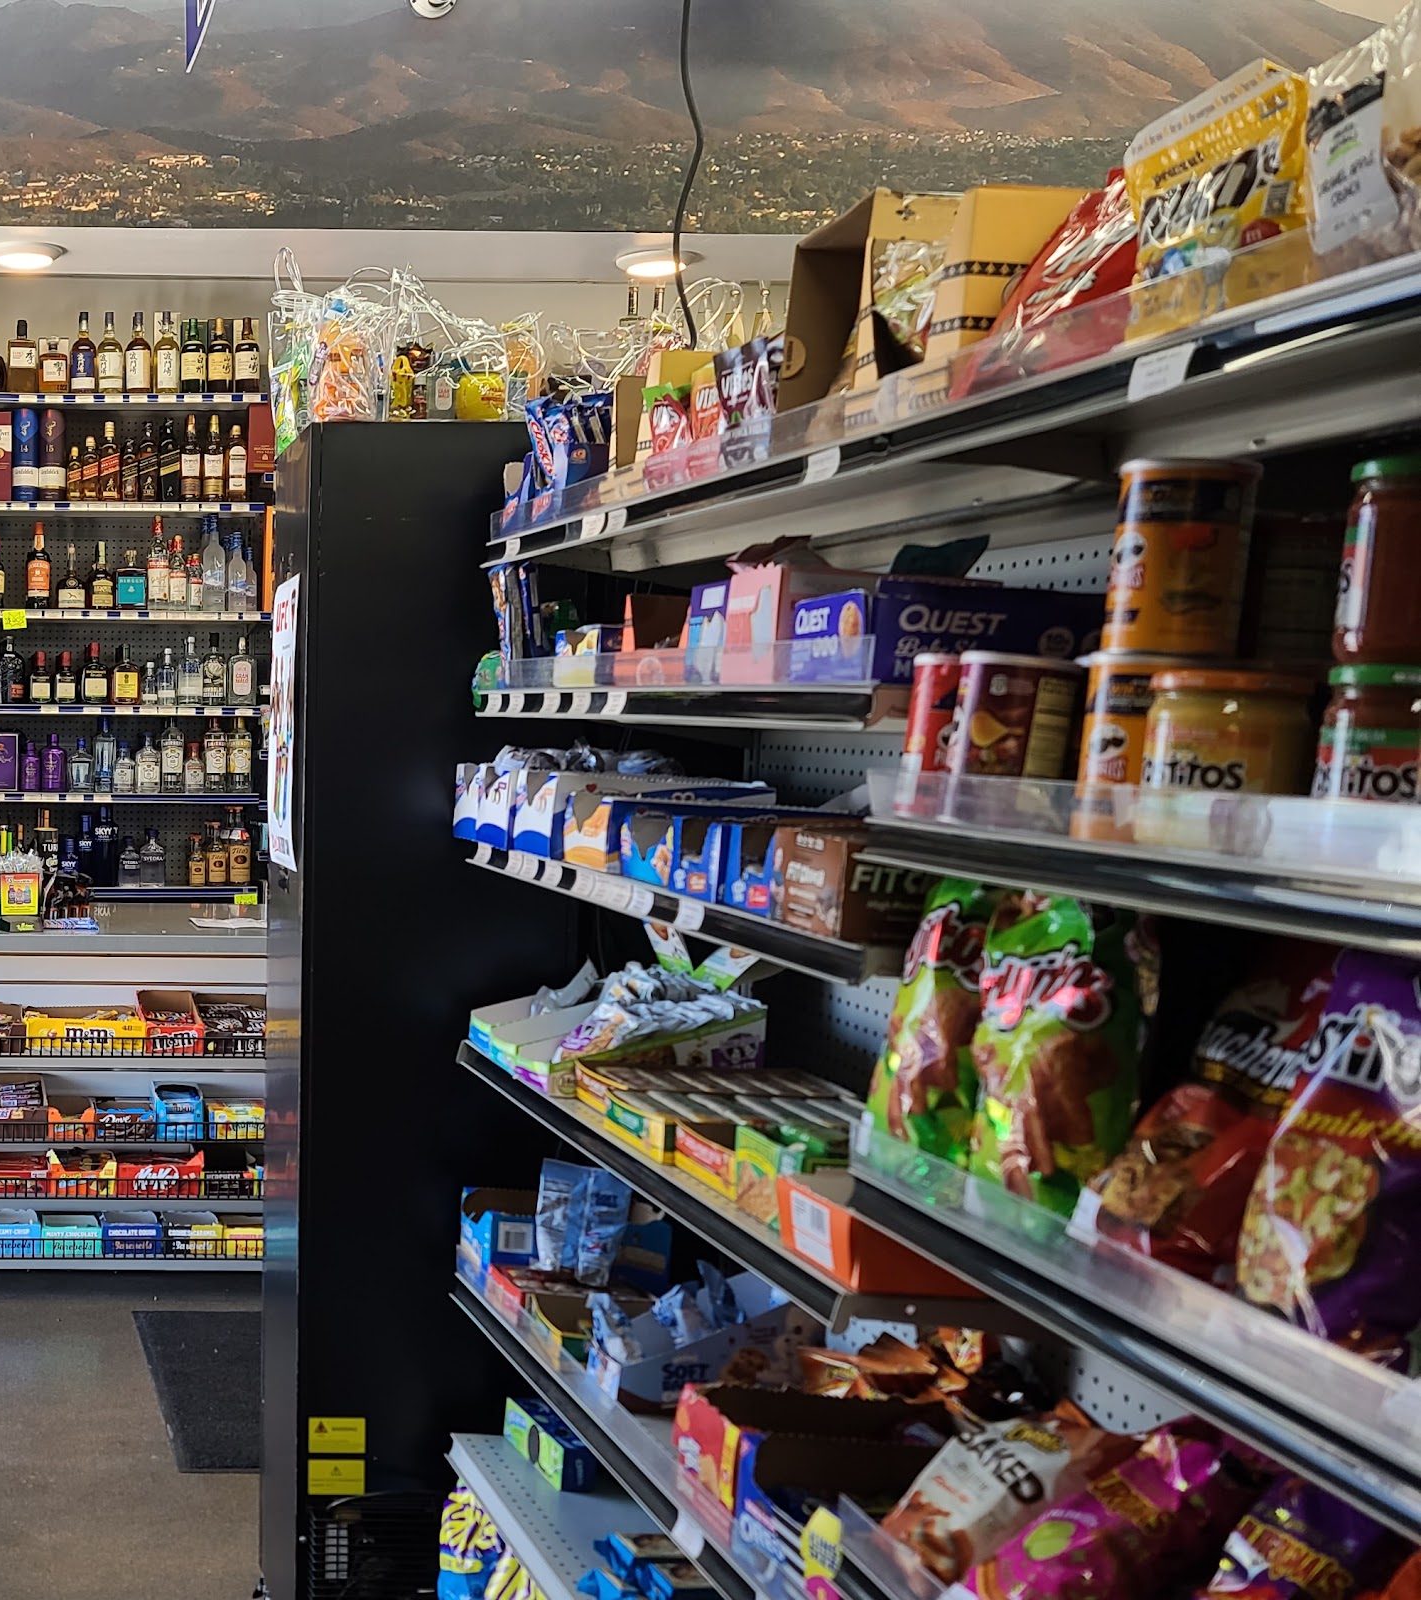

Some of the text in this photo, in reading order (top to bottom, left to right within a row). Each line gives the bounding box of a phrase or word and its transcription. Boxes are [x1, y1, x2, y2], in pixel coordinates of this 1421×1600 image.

[1152, 151, 1204, 188] peanut
[20, 444, 28, 452] 14
[45, 444, 54, 452] 15
[275, 599, 289, 633] UFC
[795, 606, 831, 635] QUEST
[898, 604, 1008, 636] QUEST
[95, 827, 113, 835] SKYY
[661, 1363, 711, 1379] SOFT
